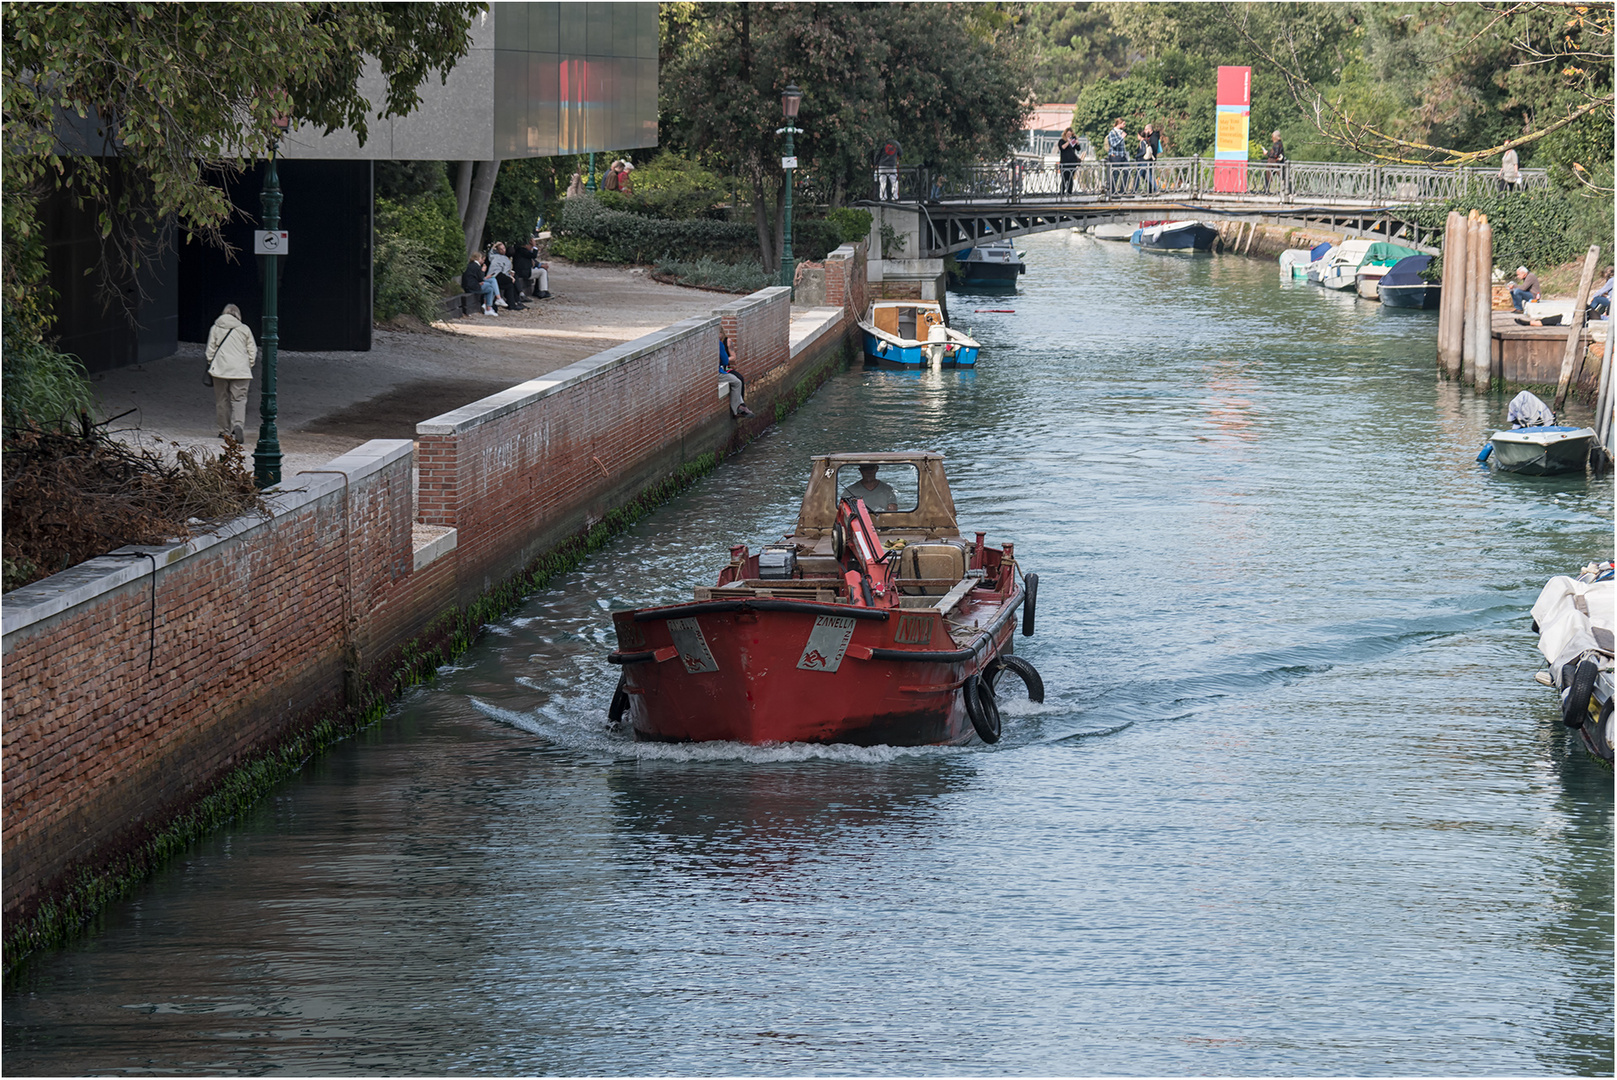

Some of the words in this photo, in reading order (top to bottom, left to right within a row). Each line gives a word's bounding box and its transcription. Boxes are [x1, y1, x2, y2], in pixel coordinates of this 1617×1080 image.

[816, 616, 854, 629] ZANELLA
[898, 618, 930, 642] NINA
[835, 630, 851, 661] NELLO
